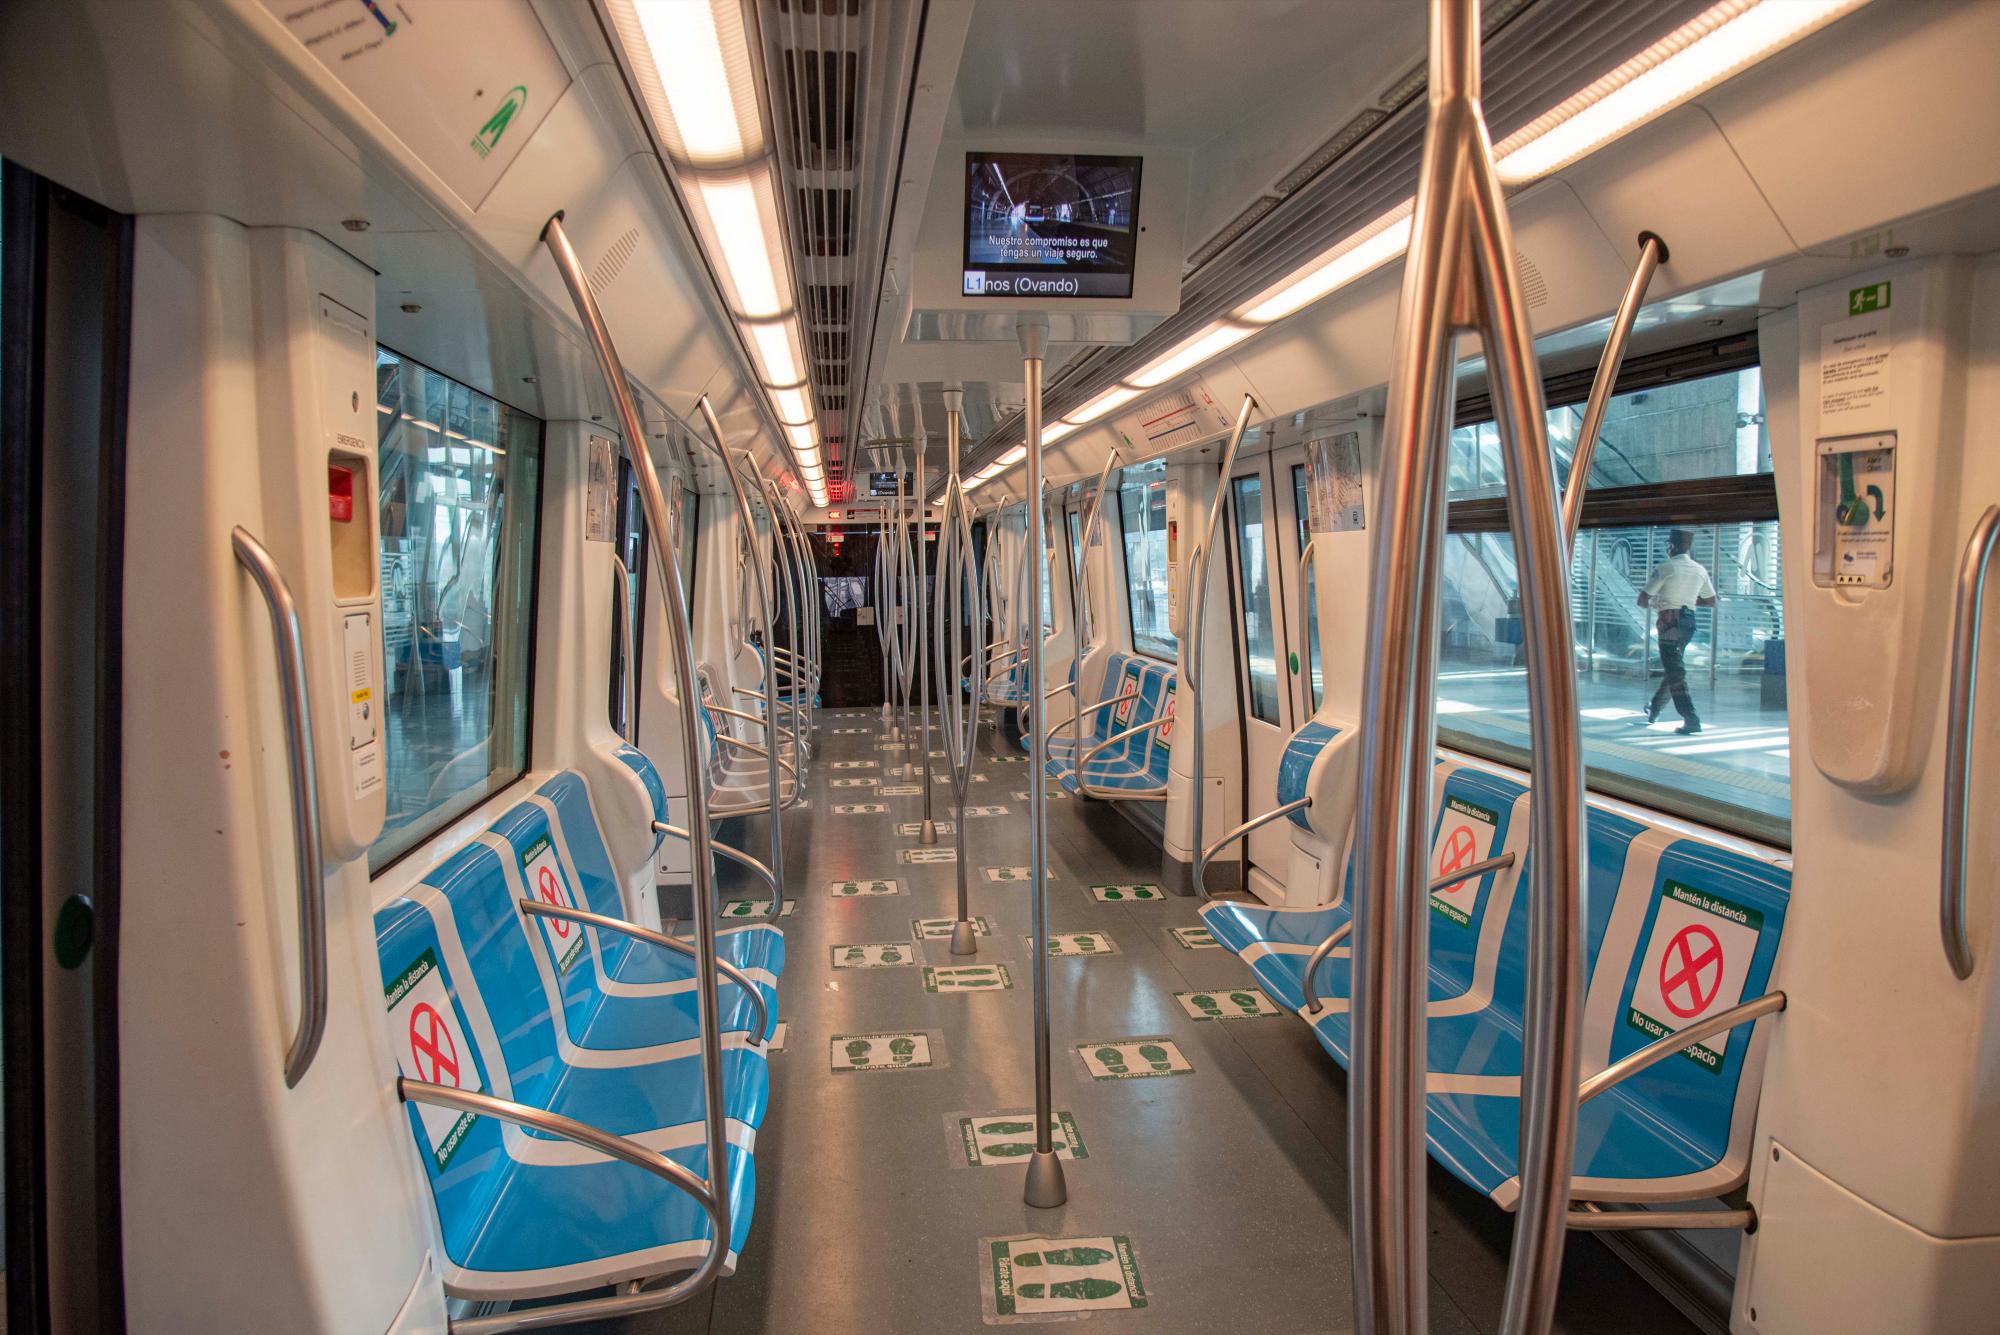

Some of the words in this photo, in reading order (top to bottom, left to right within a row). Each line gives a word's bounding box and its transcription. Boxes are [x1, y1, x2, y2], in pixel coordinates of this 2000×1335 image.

[989, 235, 1022, 246] Nuestro
[1025, 236, 1078, 248] compromiso
[1080, 239, 1089, 247] es
[1092, 239, 1108, 249] que
[1000, 248, 1029, 258] tengas
[1031, 249, 1042, 257] un
[1044, 248, 1064, 260] viaje
[1066, 250, 1098, 261] seguro.
[966, 276, 982, 290] L1
[1014, 277, 1079, 295] (Ovando)
[1673, 886, 1702, 906] Mantén
[1702, 897, 1710, 910] la
[1711, 901, 1748, 923] distancia
[402, 979, 409, 990] la
[408, 960, 429, 985] distancia
[1632, 1011, 1644, 1026] No
[1645, 1019, 1662, 1036] usar
[1683, 1045, 1716, 1066] spacio
[438, 1147, 448, 1164] No
[447, 1131, 458, 1152] usar
[457, 1117, 468, 1136] este
[998, 1257, 1010, 1279] Párate
[999, 1279, 1013, 1296] aquí
